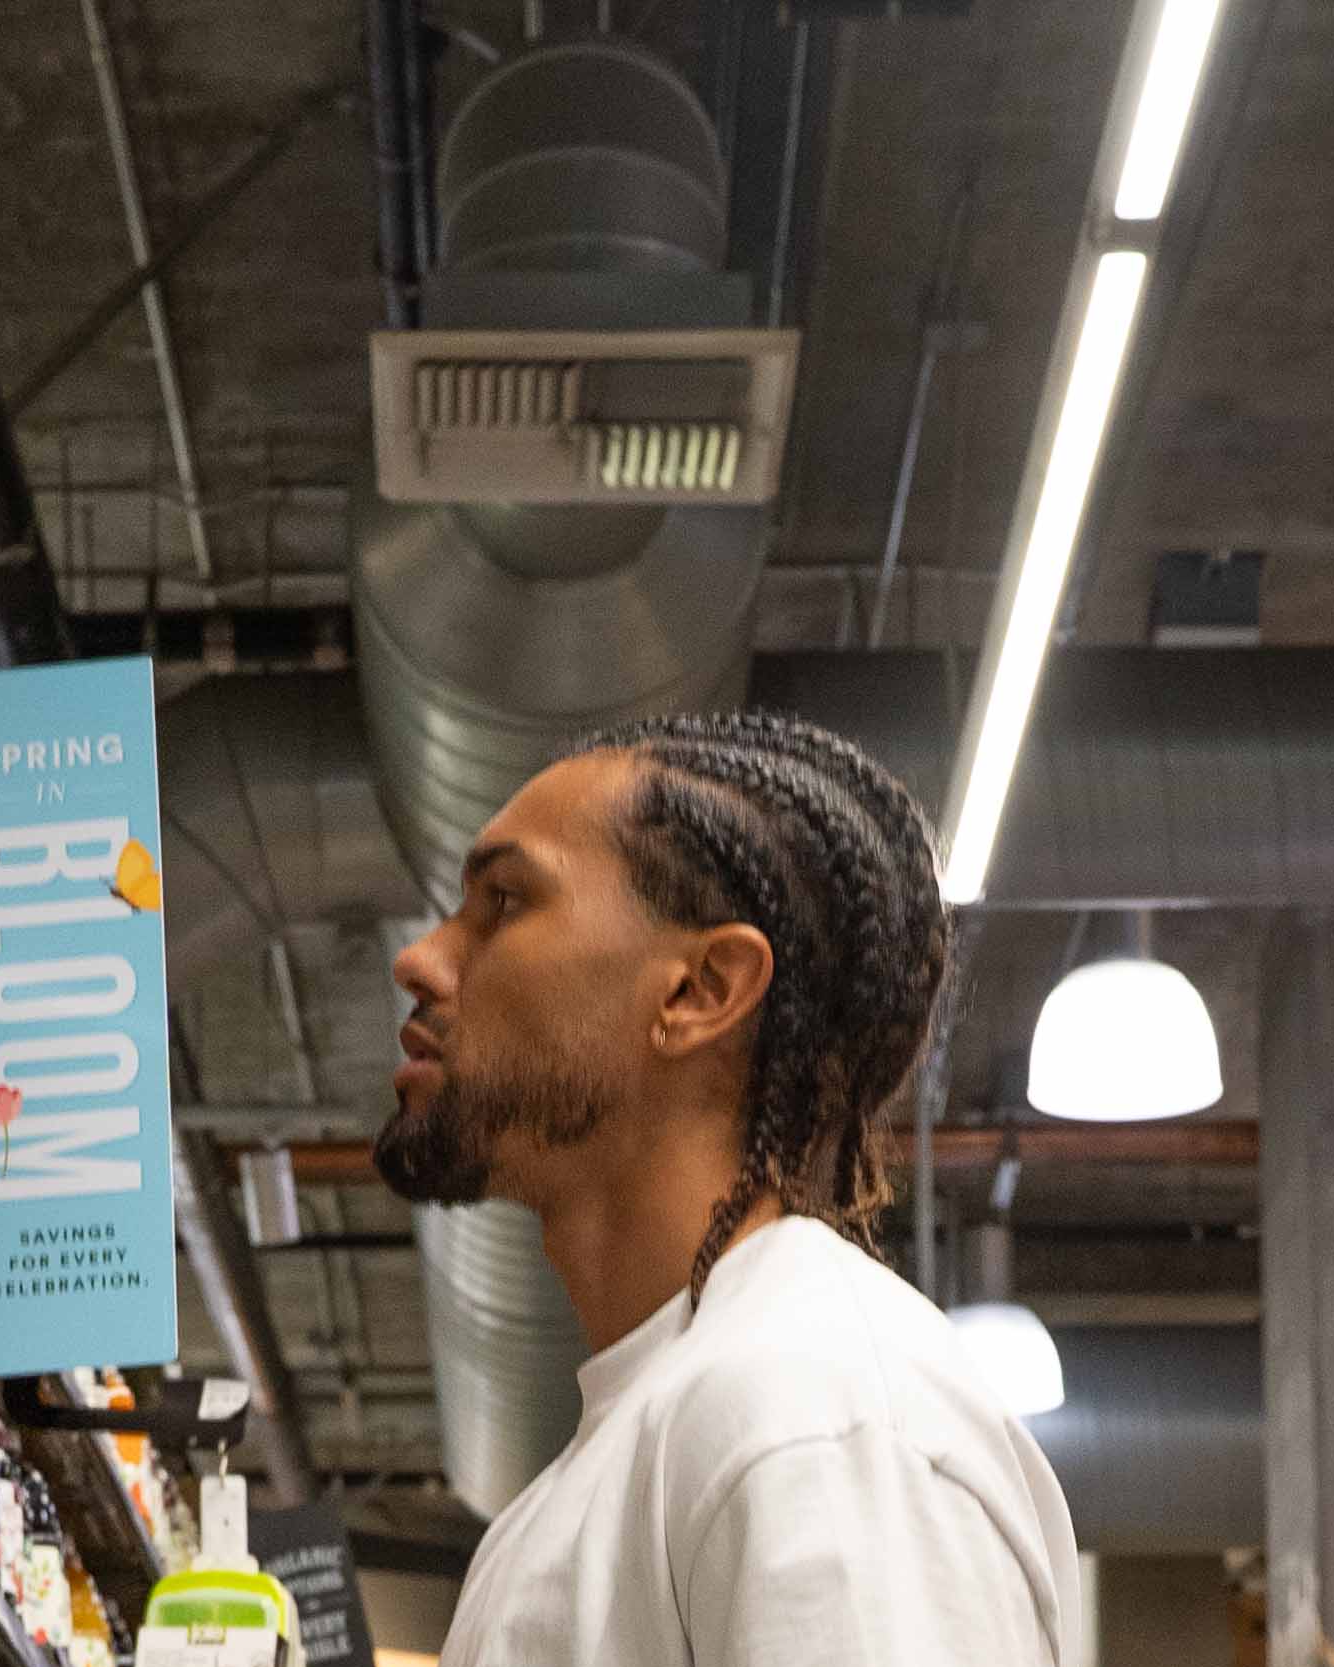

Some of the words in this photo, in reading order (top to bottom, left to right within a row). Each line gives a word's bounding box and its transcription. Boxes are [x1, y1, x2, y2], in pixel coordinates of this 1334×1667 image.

[36, 781, 66, 805] IN
[19, 1224, 116, 1246] SAVINGS
[8, 1251, 51, 1271] FOR
[58, 1246, 127, 1267] EVERY
